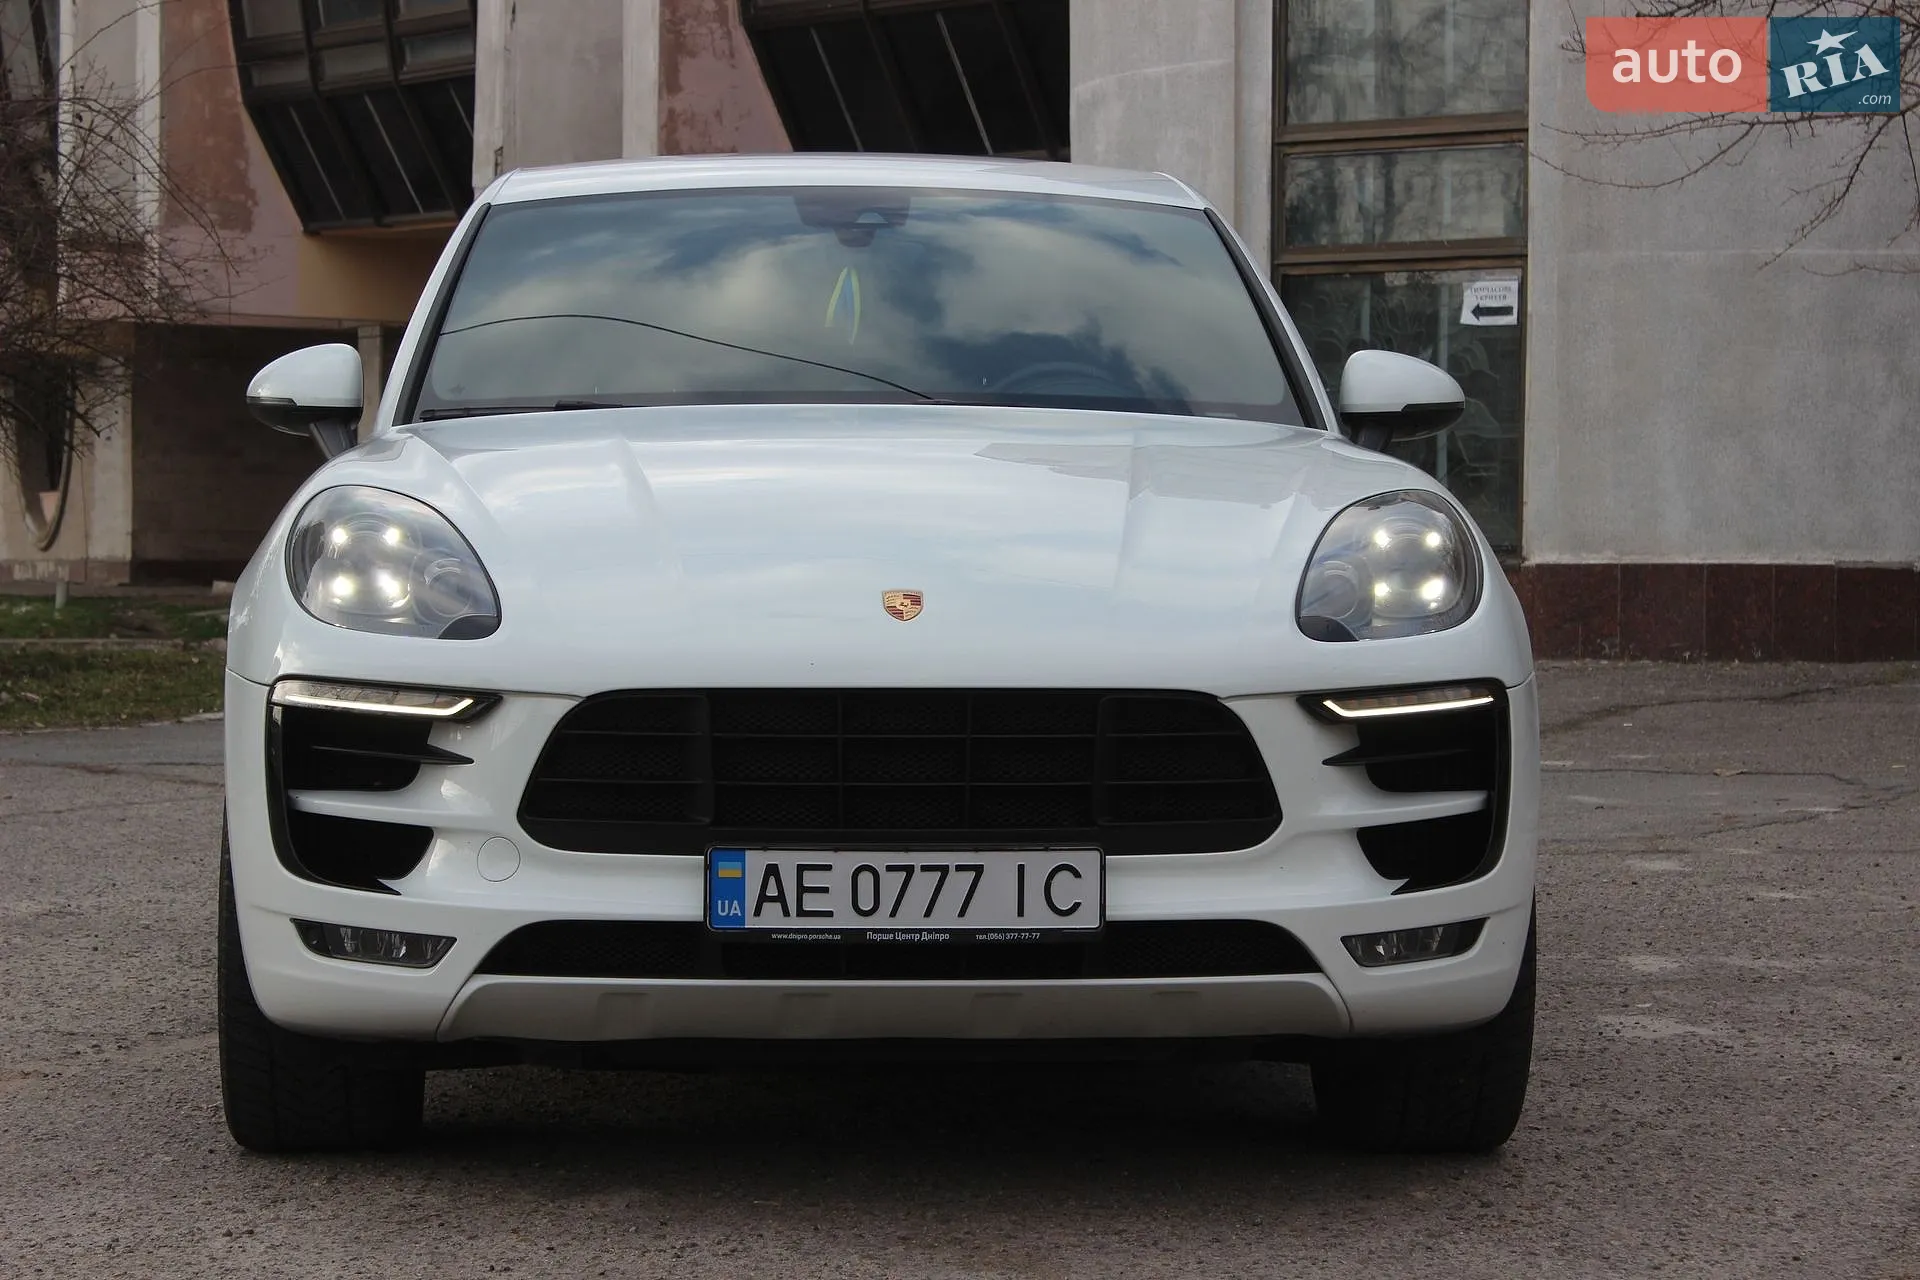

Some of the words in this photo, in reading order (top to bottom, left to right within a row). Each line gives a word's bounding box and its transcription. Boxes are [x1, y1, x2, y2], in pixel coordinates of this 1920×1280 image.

[752, 863, 834, 918] AE
[850, 863, 985, 918] 0777
[1016, 863, 1083, 918] IC
[717, 900, 742, 917] UA
[771, 932, 841, 941] www.dnipro.porsche.ua
[866, 931, 894, 942] Порше
[895, 931, 920, 942] Центр
[921, 931, 950, 942] Дніпро
[1005, 932, 1041, 940] 377-77-77
